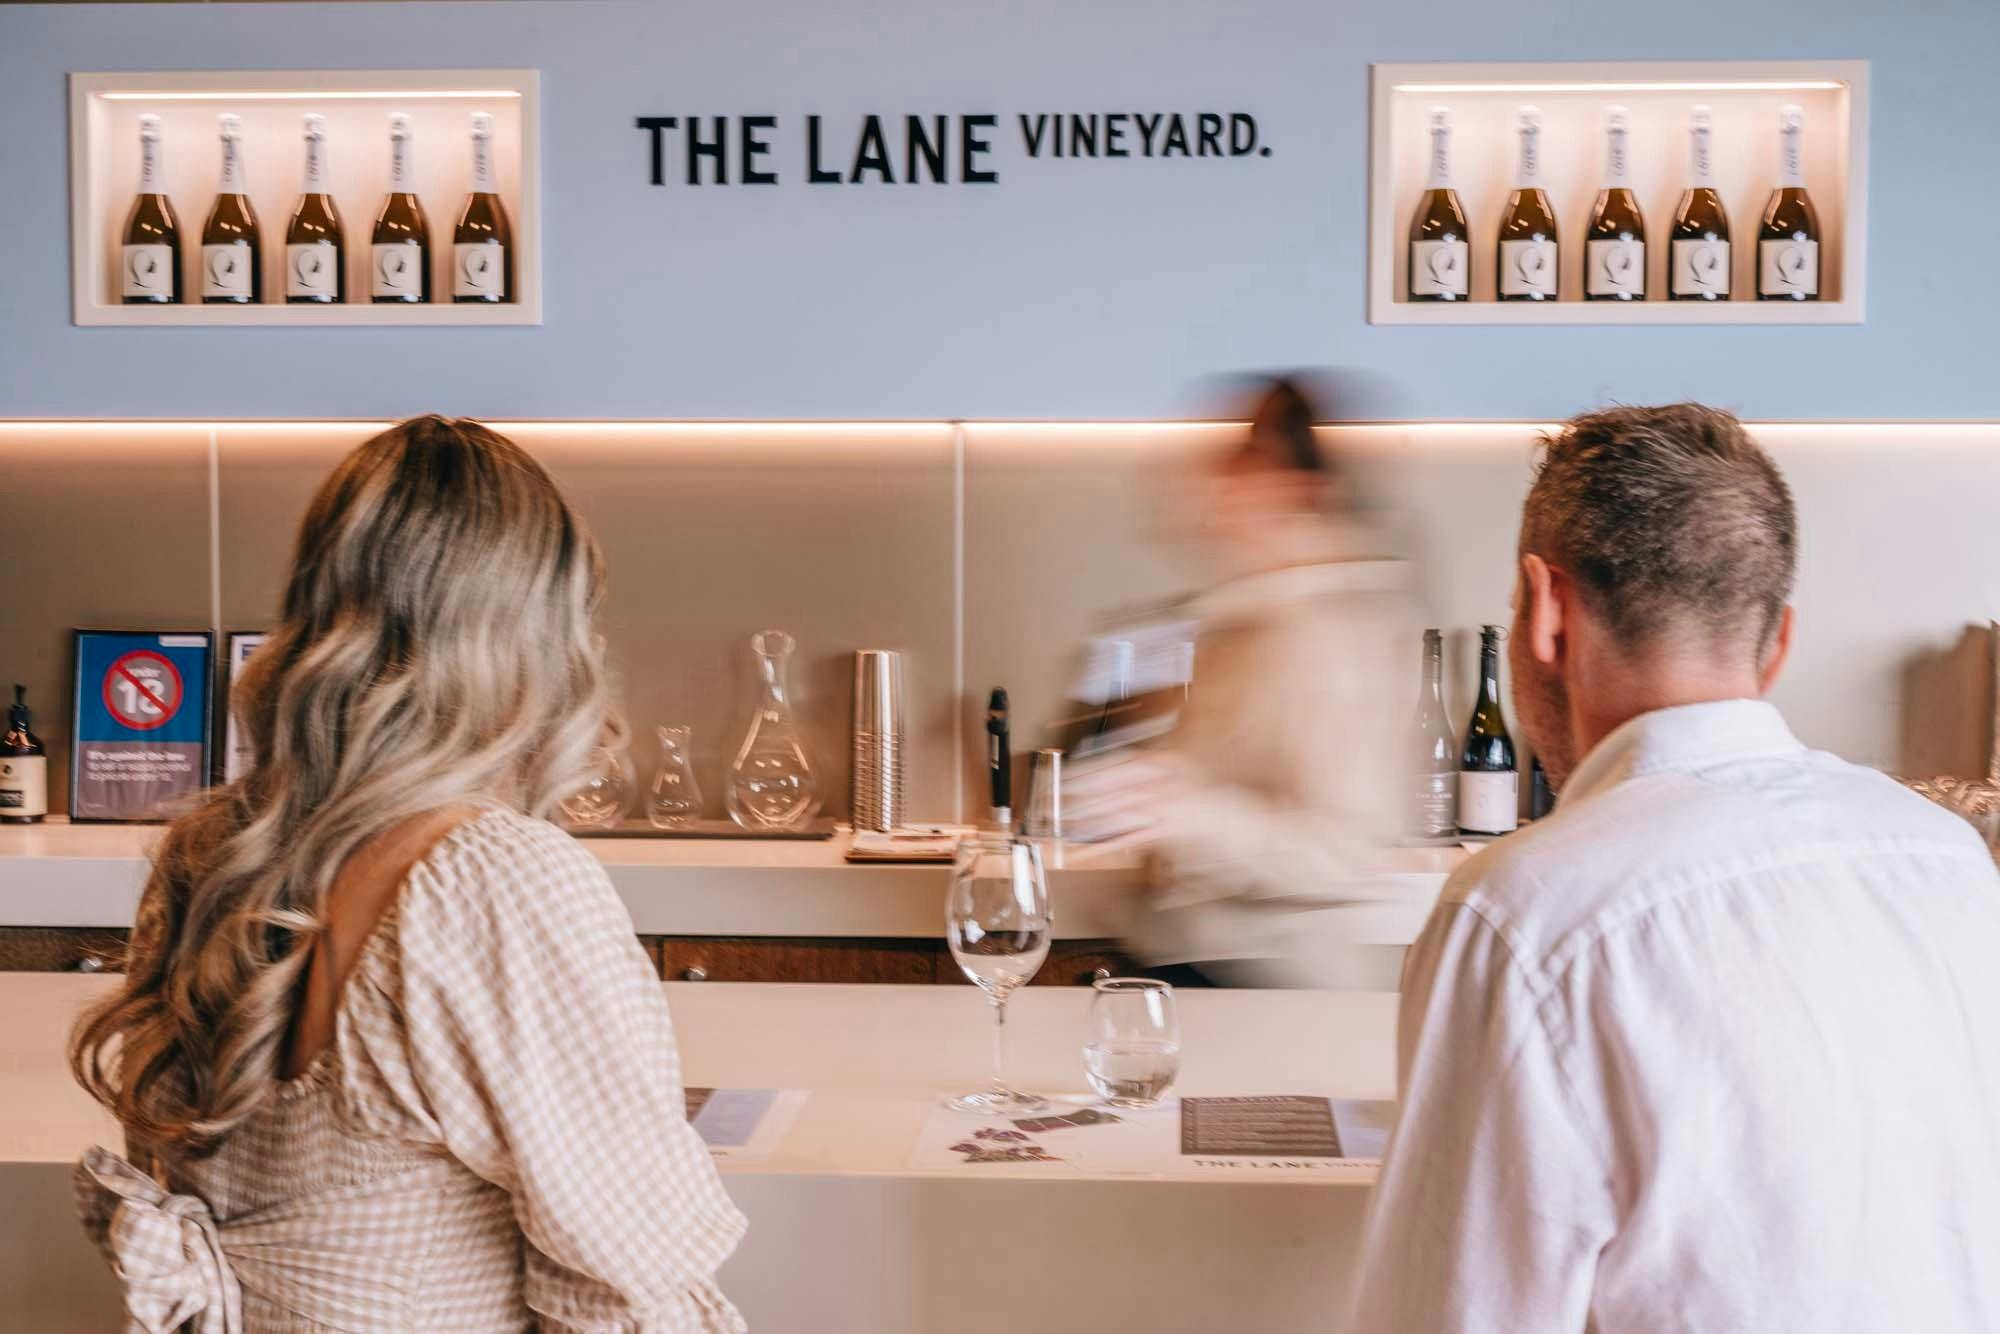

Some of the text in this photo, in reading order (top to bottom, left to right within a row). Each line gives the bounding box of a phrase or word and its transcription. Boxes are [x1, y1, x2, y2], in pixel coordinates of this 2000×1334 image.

[635, 112, 1273, 185] THE LANE VINEYARD.
[118, 678, 165, 715] 18
